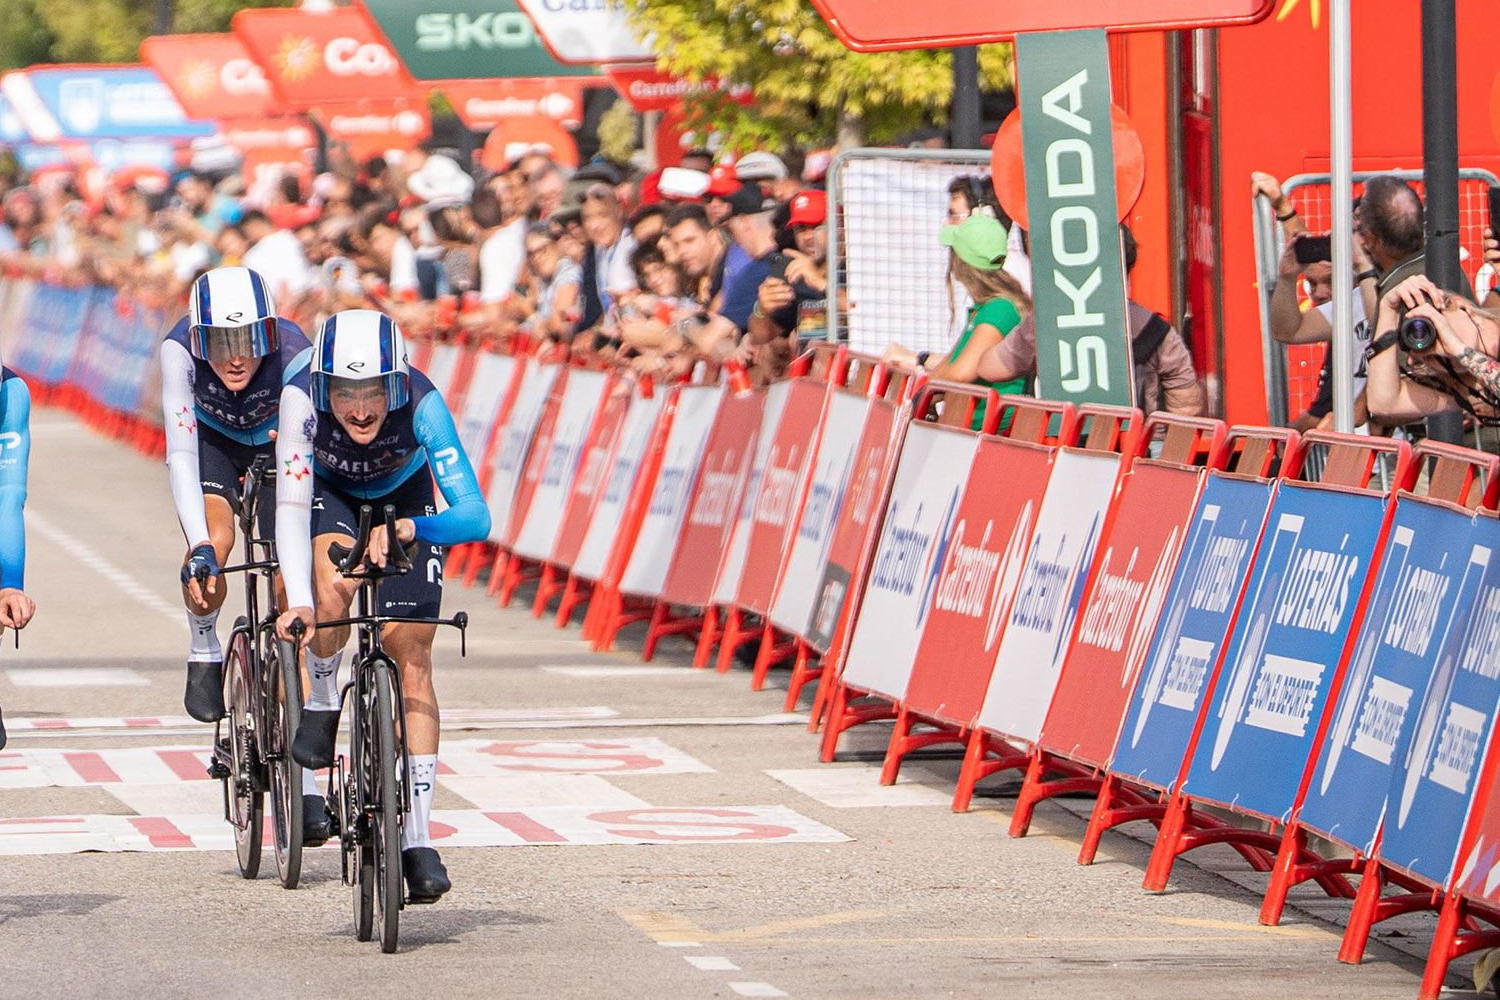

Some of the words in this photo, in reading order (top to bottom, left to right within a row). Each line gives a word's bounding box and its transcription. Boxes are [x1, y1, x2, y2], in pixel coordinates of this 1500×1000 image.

[935, 518, 1000, 618] Carrefour
[1078, 546, 1144, 652] Carrefour
[1276, 534, 1358, 634] LOTERÍAS
